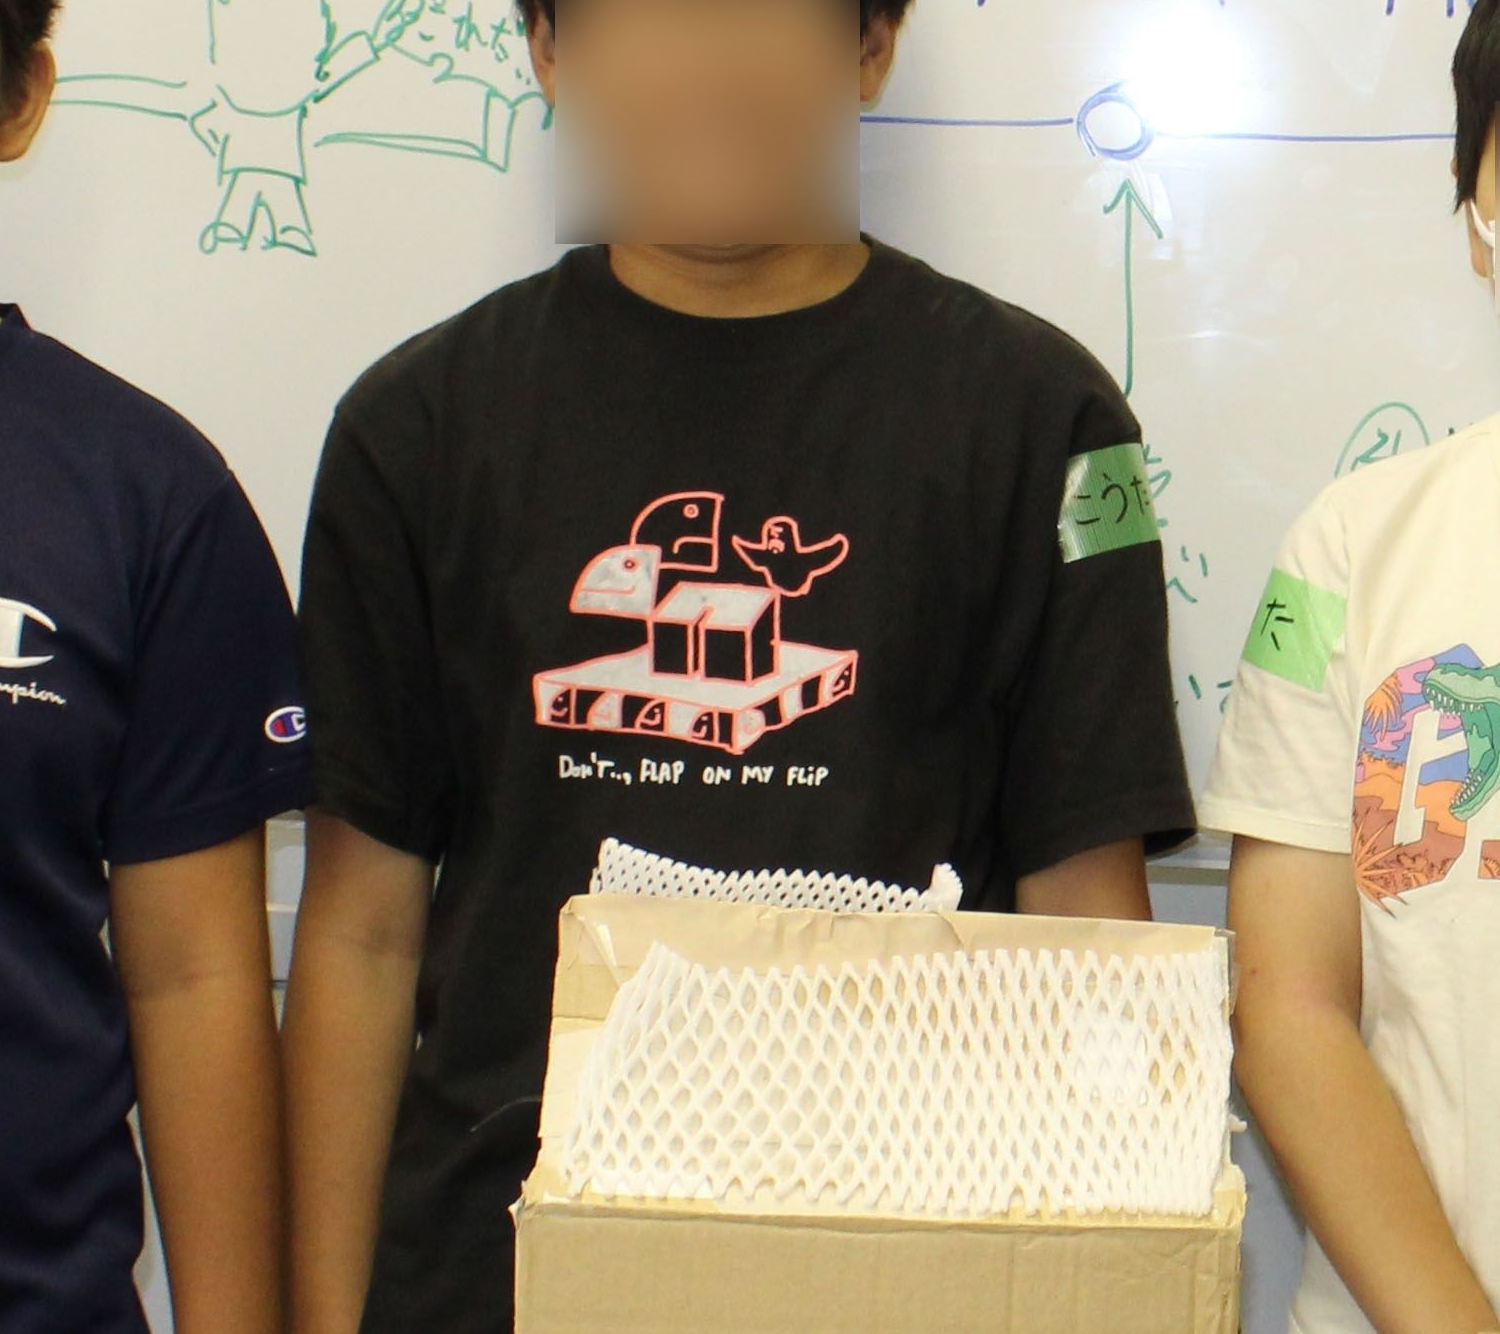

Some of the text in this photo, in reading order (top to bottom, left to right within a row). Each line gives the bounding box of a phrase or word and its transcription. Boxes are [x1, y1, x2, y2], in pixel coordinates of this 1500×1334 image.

[640, 758, 685, 785] FLAP
[702, 765, 732, 785] ON
[741, 765, 774, 784] MY
